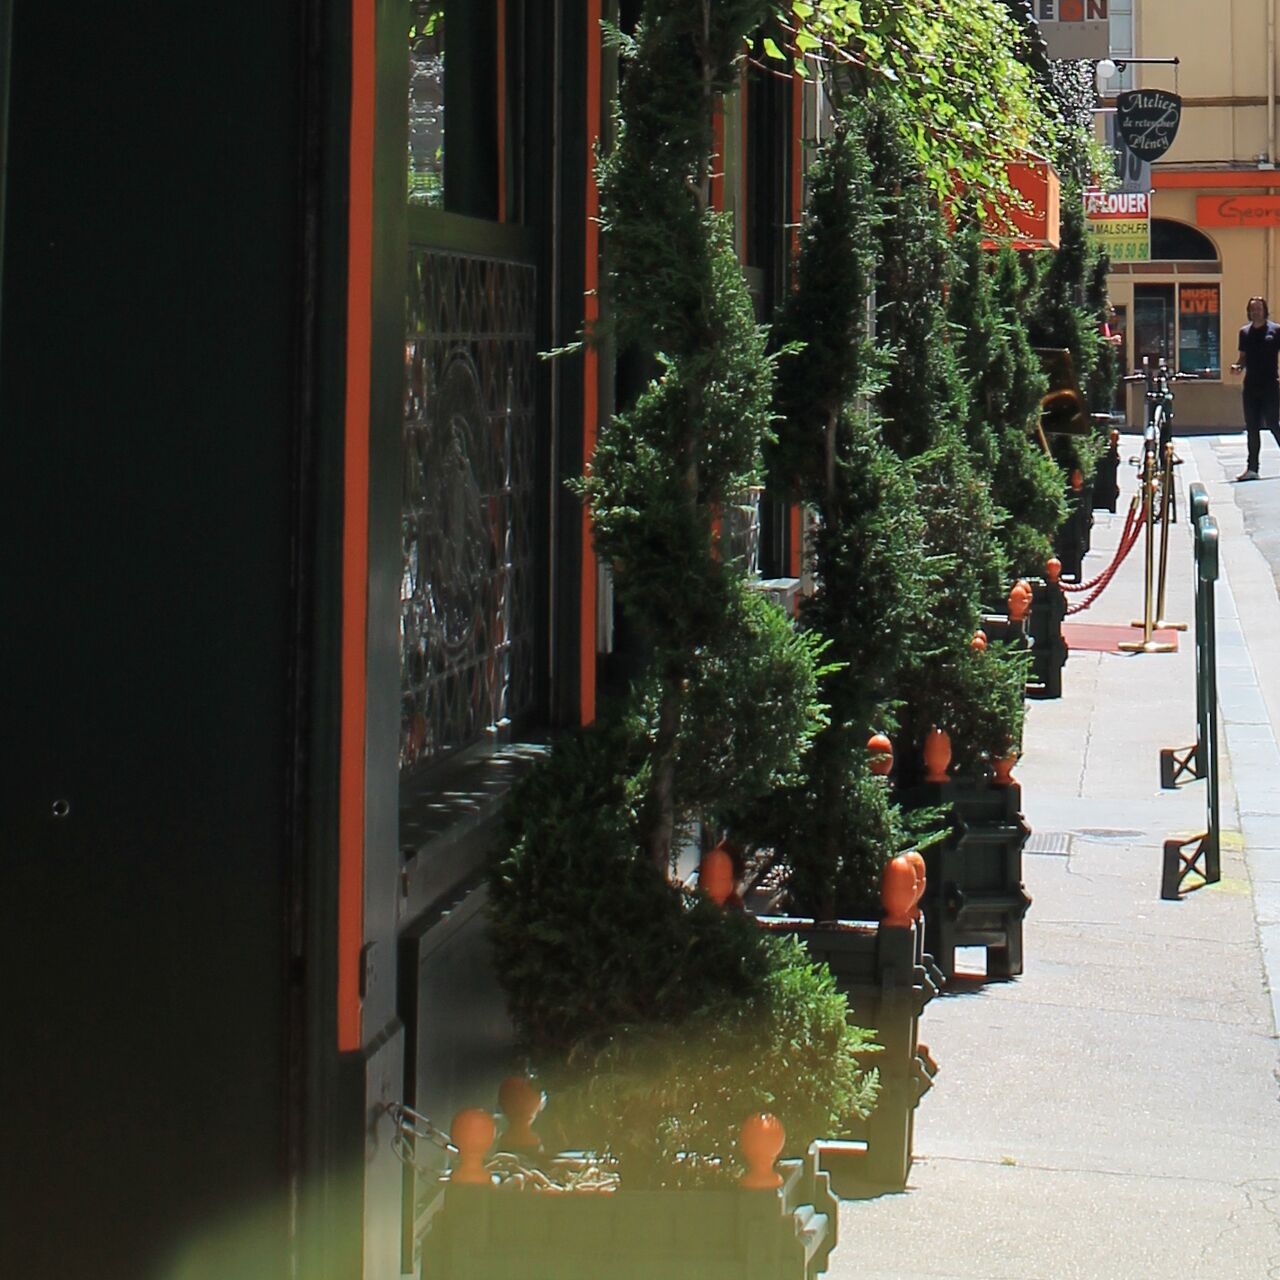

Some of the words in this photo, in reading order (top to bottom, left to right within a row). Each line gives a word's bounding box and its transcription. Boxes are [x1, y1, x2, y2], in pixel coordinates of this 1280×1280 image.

[1122, 93, 1177, 113] Atelier
[1123, 117, 1132, 127] de
[1101, 193, 1147, 213] LOUER
[1181, 300, 1218, 314] LIVE
